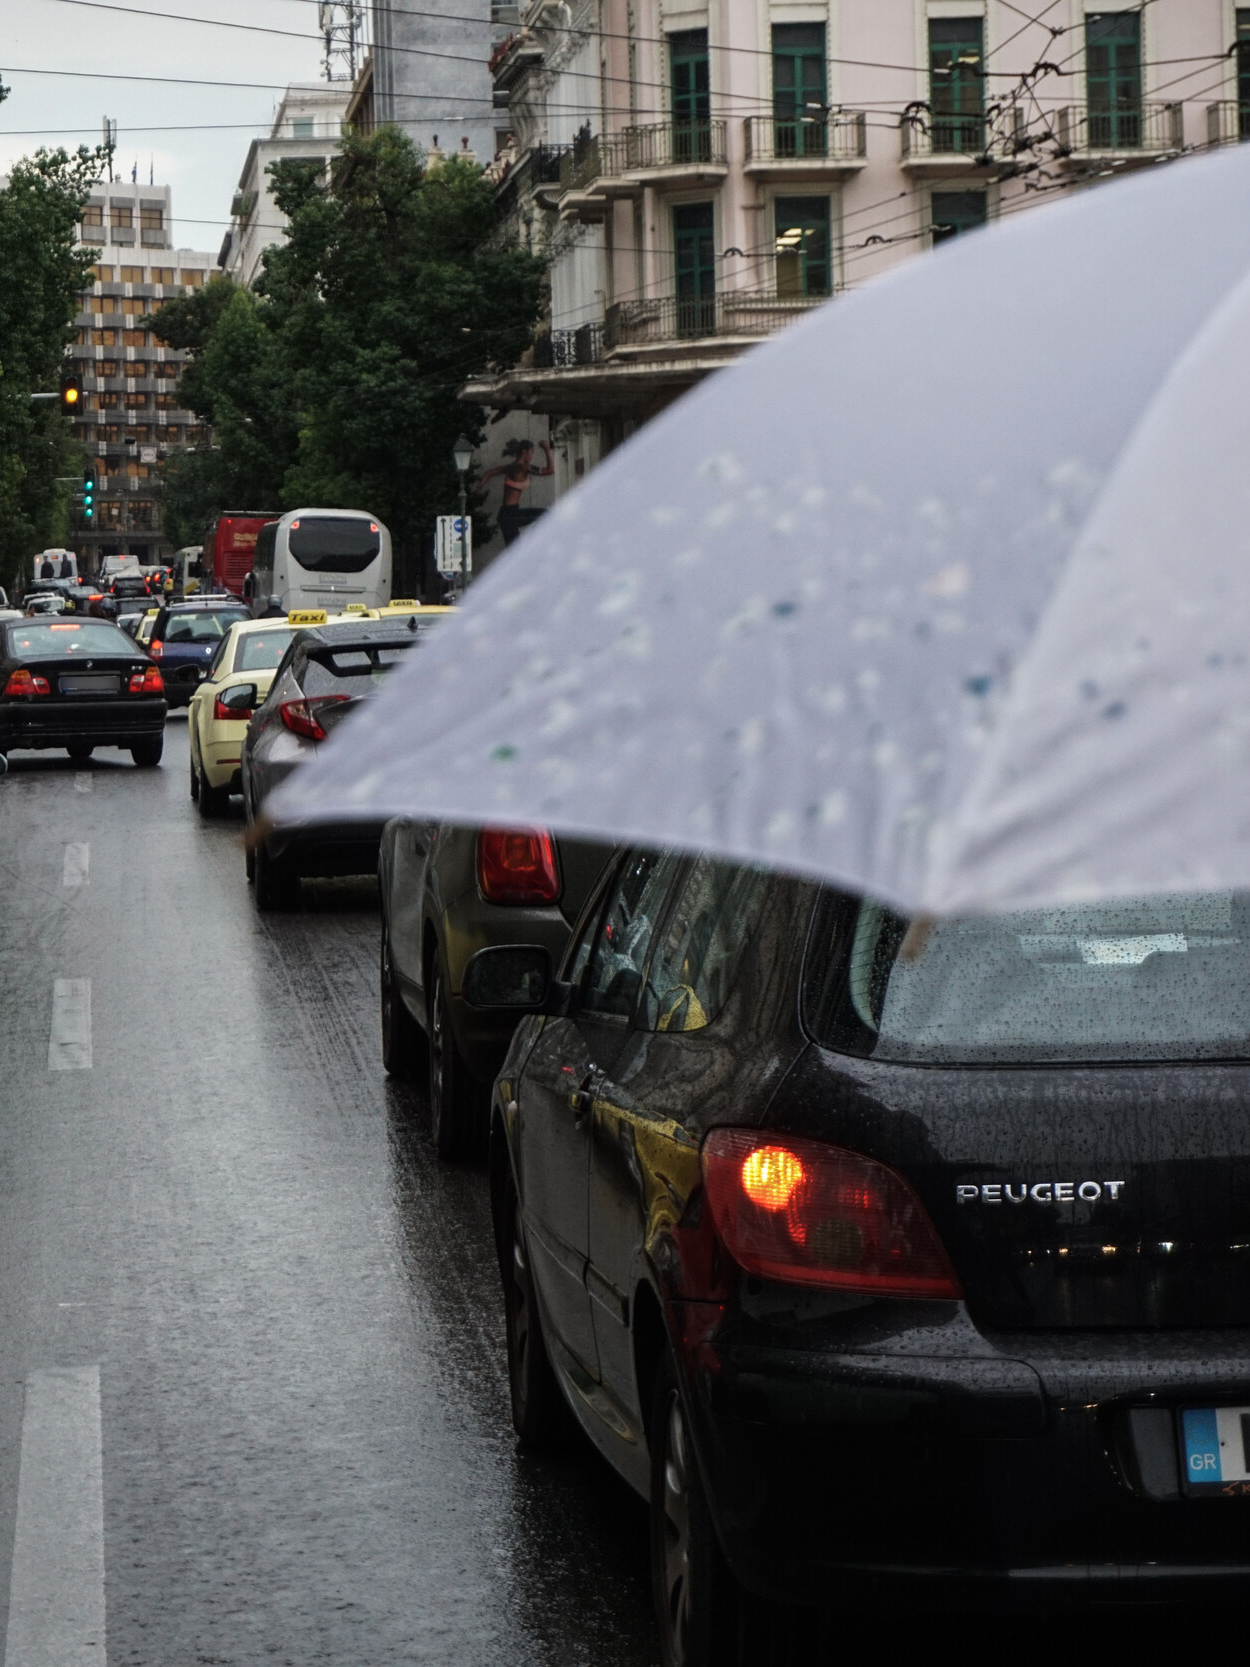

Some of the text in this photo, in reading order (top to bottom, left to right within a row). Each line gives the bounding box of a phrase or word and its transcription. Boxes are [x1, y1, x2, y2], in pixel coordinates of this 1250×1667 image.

[291, 613, 325, 622] Taxi
[956, 1181, 1126, 1203] PEUGEOT
[1190, 1453, 1217, 1470] GR
